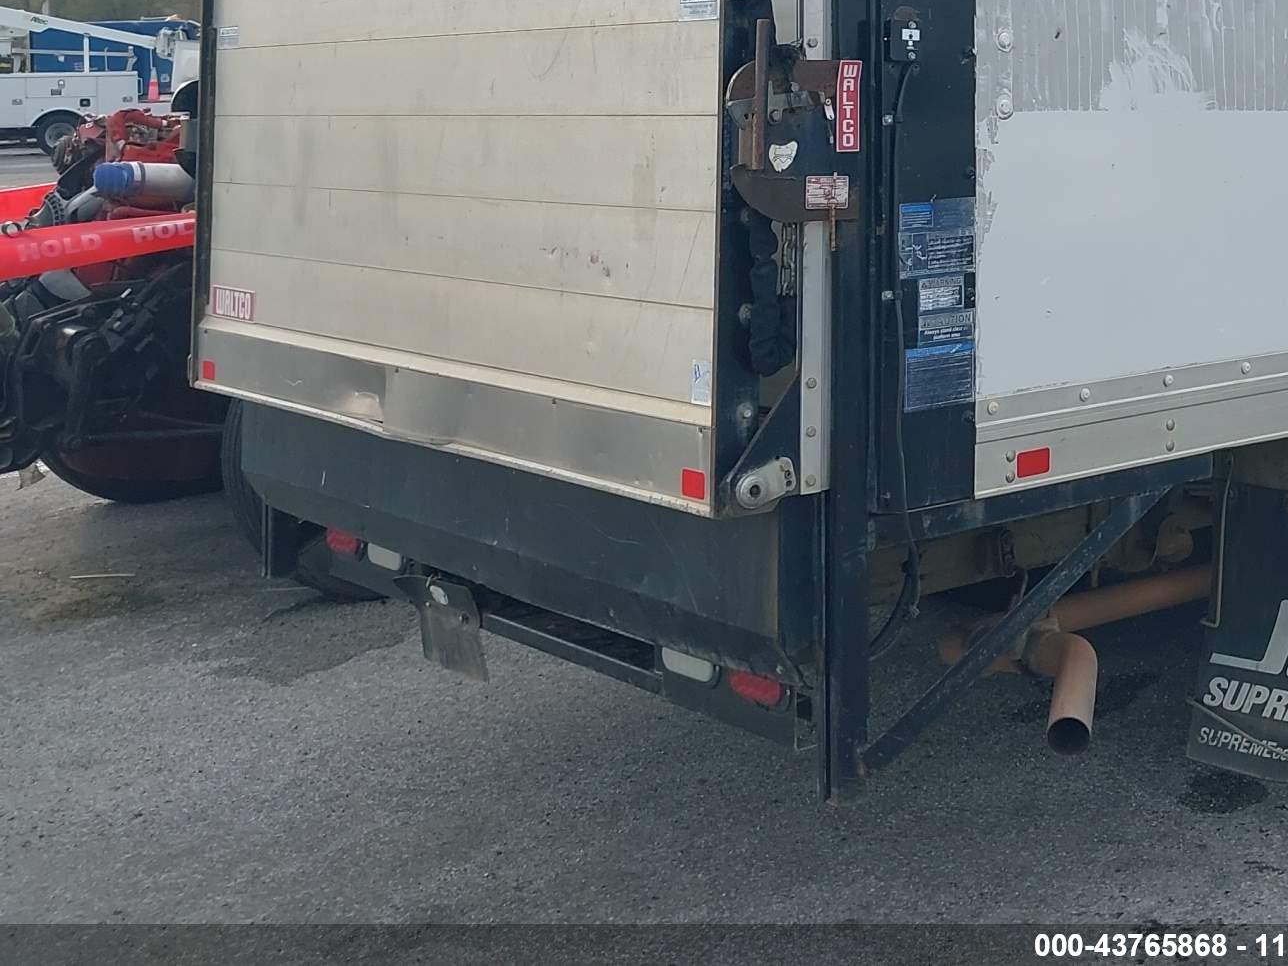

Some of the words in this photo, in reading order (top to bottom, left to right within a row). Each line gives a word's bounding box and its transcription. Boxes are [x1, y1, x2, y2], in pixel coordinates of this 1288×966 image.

[842, 64, 858, 147] WALTCO
[16, 233, 103, 262] HOLD
[215, 288, 251, 320] WALTCO
